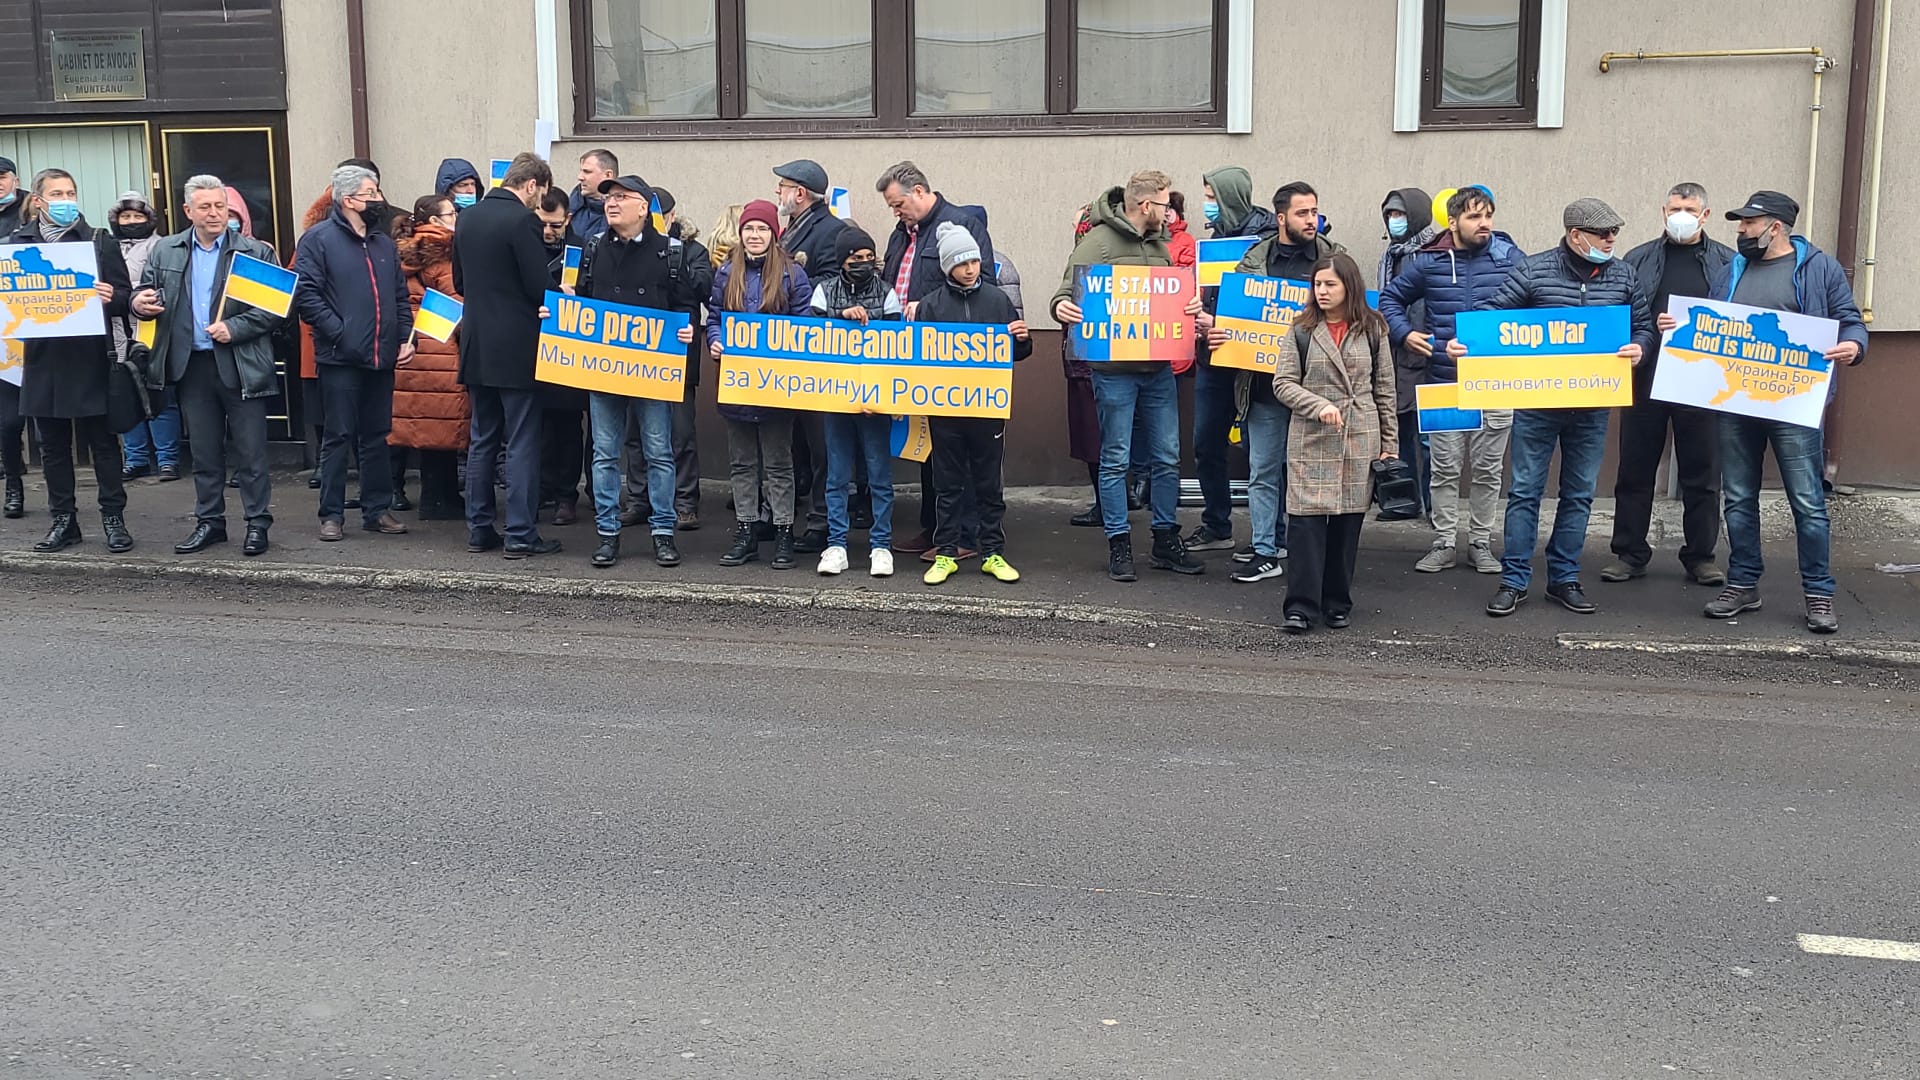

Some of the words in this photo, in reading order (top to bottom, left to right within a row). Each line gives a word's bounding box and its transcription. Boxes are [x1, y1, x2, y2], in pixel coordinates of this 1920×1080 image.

[58, 52, 91, 70] CABINET
[94, 52, 104, 69] DE
[107, 52, 136, 69] AVOCAT
[14, 272, 48, 290] with
[49, 273, 77, 291] you
[1086, 276, 1113, 293] WE
[1119, 277, 1181, 294] STAND
[6, 293, 62, 306] Украина
[66, 291, 87, 302] Бог
[1280, 280, 1309, 306] împ
[33, 303, 73, 315] тобой
[1105, 298, 1150, 315] WITH
[558, 298, 596, 336] We
[602, 311, 665, 350] pray
[726, 316, 761, 349] for
[1081, 322, 1183, 339] UKRAINE
[1696, 313, 1756, 341] Ukraine,
[1499, 322, 1543, 348] Stop
[1547, 321, 1588, 344] War
[921, 326, 1011, 363] Russia
[1692, 332, 1720, 353] God
[1723, 336, 1738, 355] is
[1742, 341, 1777, 361] with
[1779, 347, 1809, 367] you
[540, 342, 575, 366] Мы
[582, 355, 682, 382] молимся
[1256, 352, 1277, 366] во
[724, 369, 750, 388] за
[1726, 360, 1788, 380] Украина
[1792, 371, 1816, 385] Бог
[1464, 377, 1563, 391] остановите
[1568, 374, 1622, 392] войну
[1752, 380, 1796, 395] тобой
[892, 378, 1009, 409] Россию
